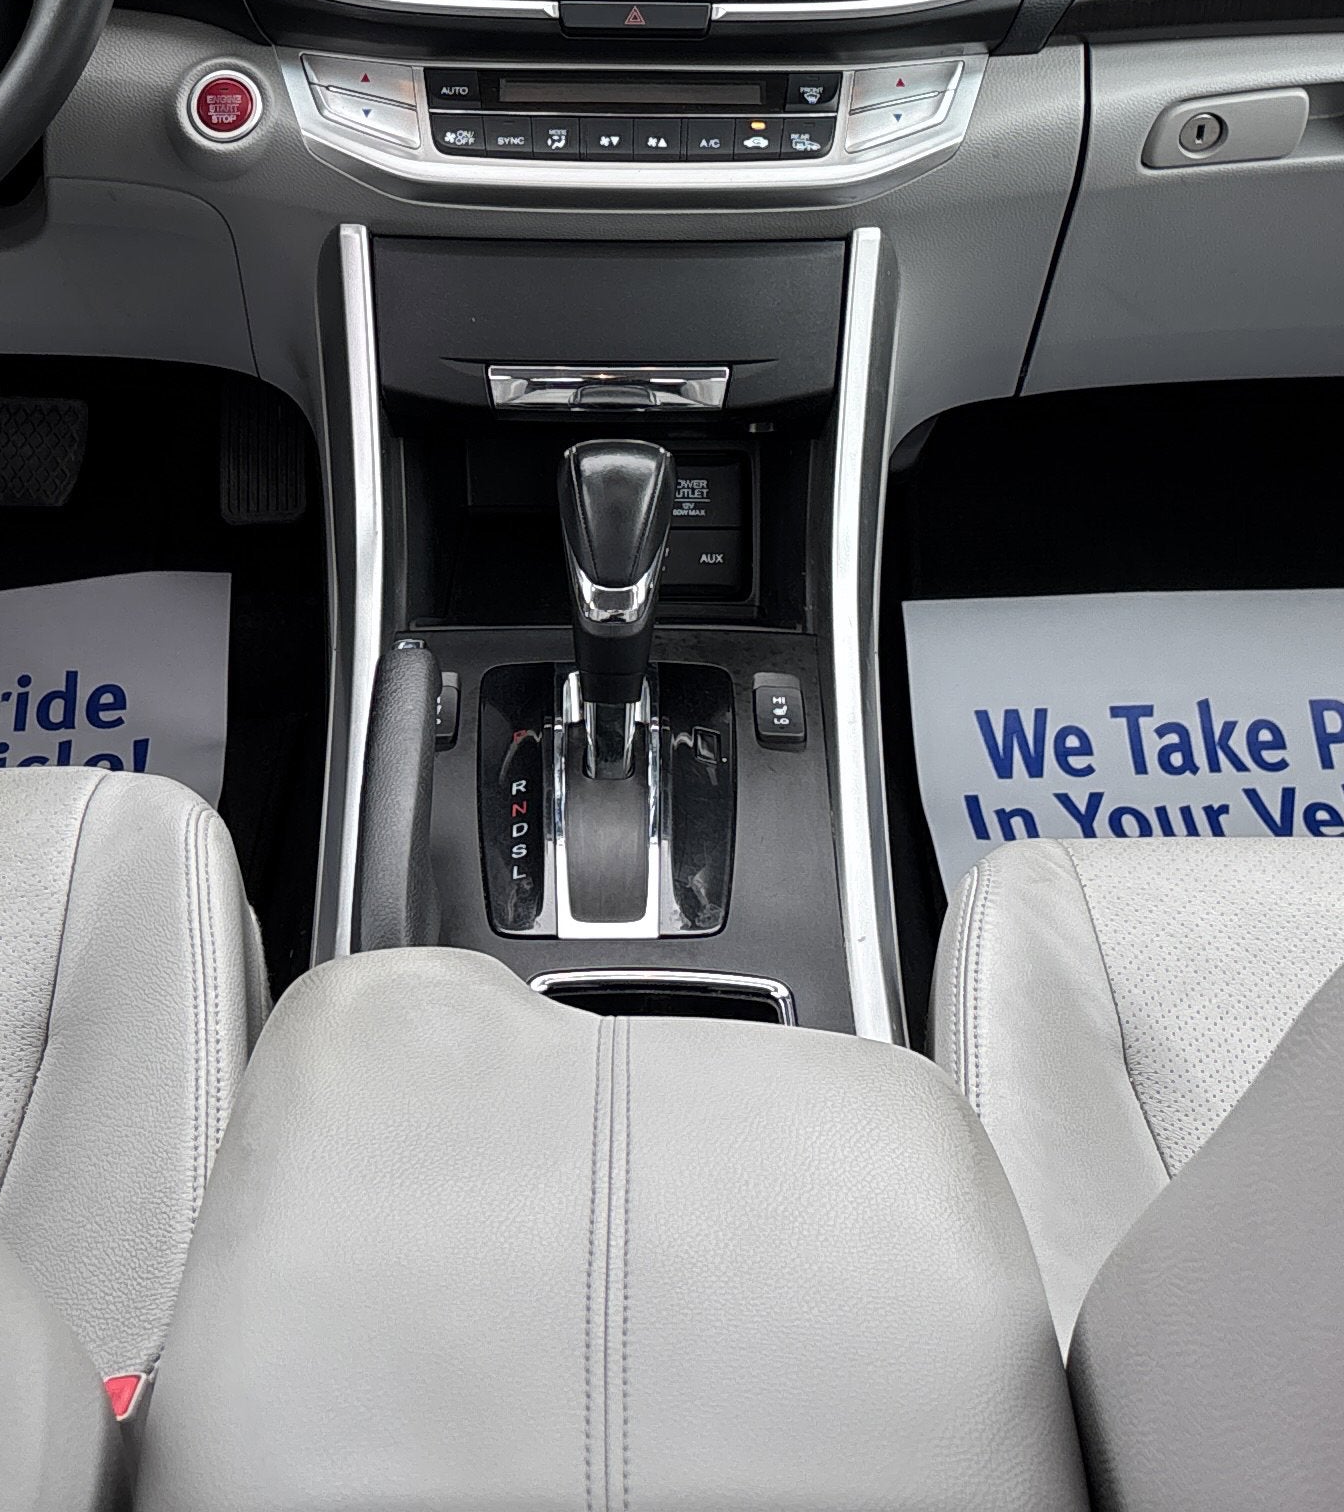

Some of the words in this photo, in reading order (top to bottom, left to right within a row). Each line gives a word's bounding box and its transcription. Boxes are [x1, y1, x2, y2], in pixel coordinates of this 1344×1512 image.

[440, 86, 469, 96] AUTO
[206, 94, 242, 104] ENGINE
[209, 104, 239, 113] START
[211, 115, 237, 124] STOP
[455, 138, 475, 146] OFF
[497, 137, 525, 145] SYNC
[699, 138, 721, 149] A/C
[677, 479, 708, 489] OWER
[676, 489, 709, 498] UTLET
[699, 553, 724, 564] AUX
[772, 696, 786, 705] HI
[974, 706, 1096, 780] We
[1109, 697, 1290, 777] Take
[511, 779, 527, 796] R
[511, 800, 527, 818] N
[963, 792, 1040, 842] In
[1053, 790, 1231, 840] Your
[512, 822, 529, 838] D
[511, 844, 528, 859] S
[512, 865, 527, 880] L
